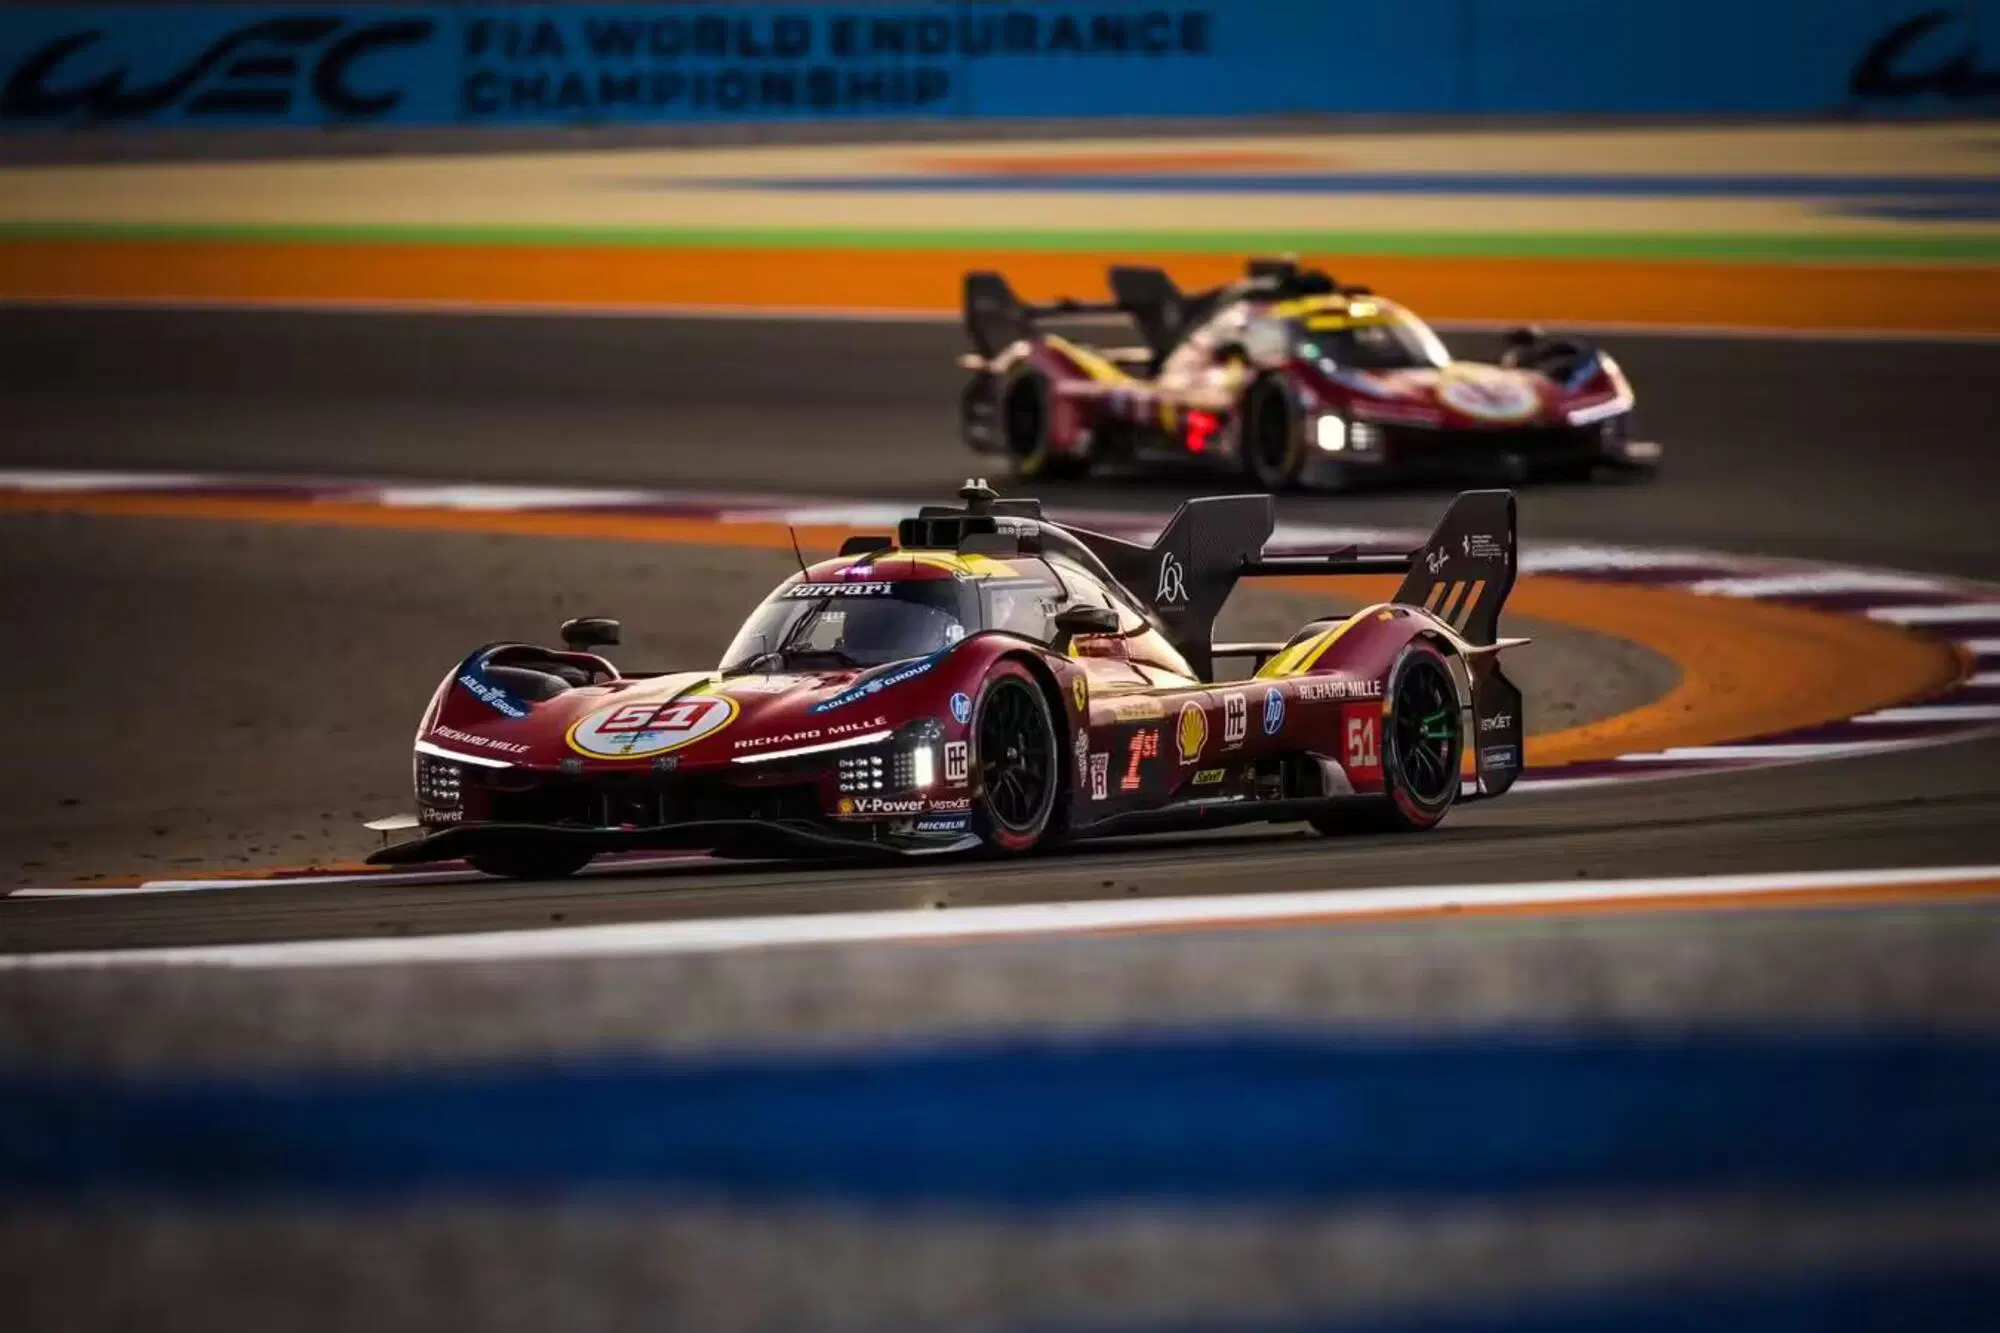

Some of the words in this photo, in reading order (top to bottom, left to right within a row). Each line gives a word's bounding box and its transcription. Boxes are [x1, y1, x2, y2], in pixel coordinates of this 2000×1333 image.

[464, 18, 566, 60] FIA
[582, 15, 812, 58] WORLD
[828, 11, 1211, 57] ENDURANCE
[2, 17, 434, 118] WEC
[462, 67, 951, 113] CHAMPIONSHIP
[783, 582, 893, 598] Ferrari
[815, 690, 866, 712] ADLER
[883, 663, 932, 687] GROUP
[1299, 682, 1346, 700] RICHARD
[1348, 680, 1382, 698] MILLE
[604, 702, 701, 729] 51
[951, 693, 971, 724] hp
[1265, 688, 1284, 735] hp
[434, 725, 490, 746] RICHARD
[487, 740, 530, 753] MILLE
[734, 731, 821, 749] RICHARD
[828, 716, 888, 736] MILLE
[1347, 717, 1378, 768] 51
[854, 798, 925, 812] V-Power
[917, 820, 966, 830] MICHELIN
